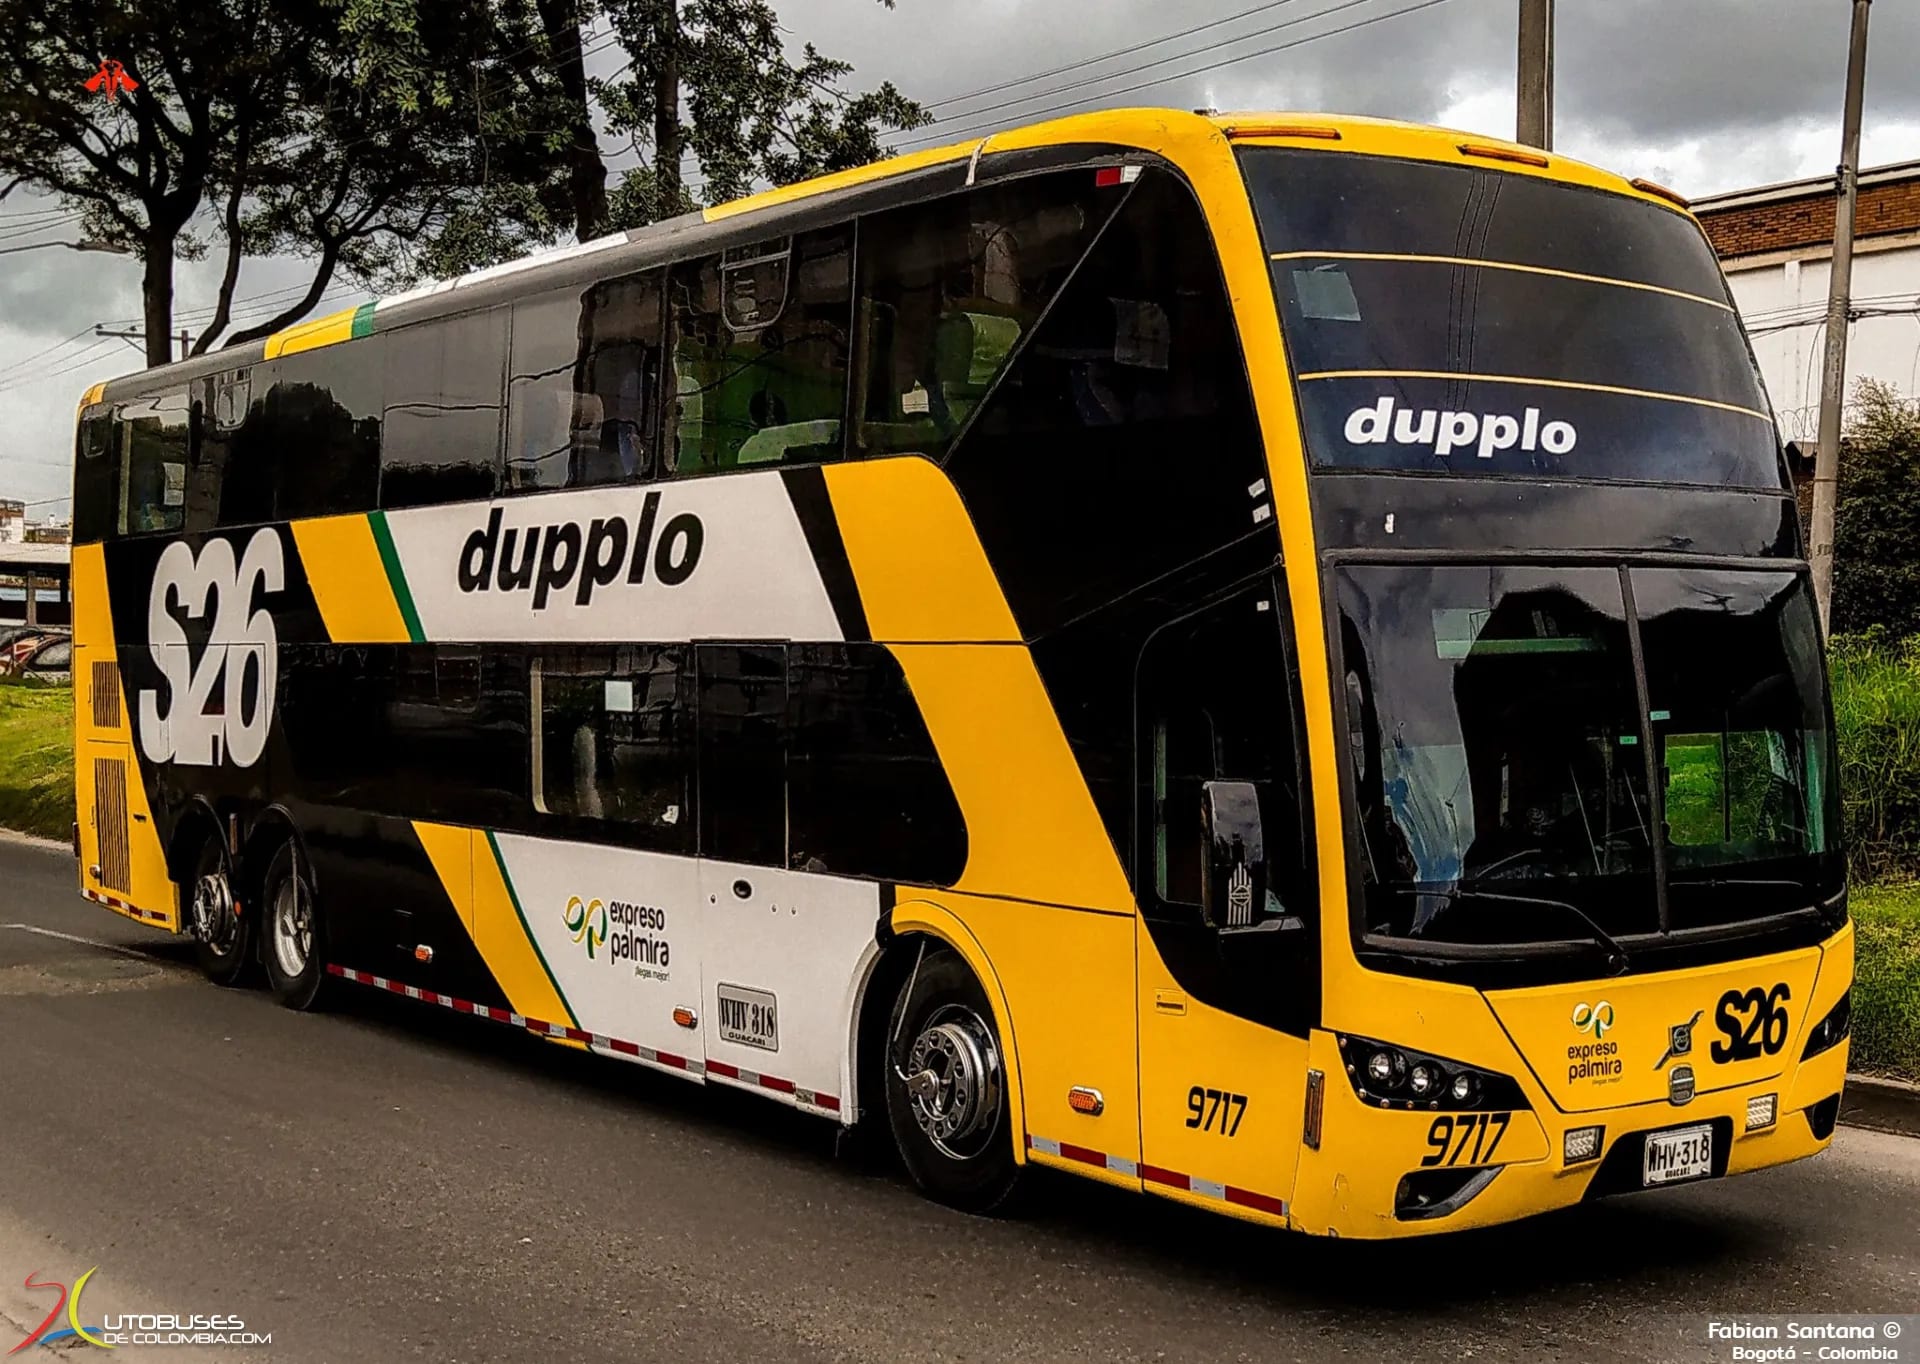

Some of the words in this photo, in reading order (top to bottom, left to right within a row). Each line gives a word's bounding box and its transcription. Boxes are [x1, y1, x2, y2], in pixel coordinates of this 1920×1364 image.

[1345, 397, 1577, 458] dupplo
[459, 492, 704, 610] dupplo
[138, 527, 285, 767] S26
[610, 900, 665, 932] expreso
[611, 929, 670, 967] palmira
[720, 998, 749, 1032] WHV
[752, 1003, 774, 1038] 318
[1711, 982, 1790, 1064] S26
[1568, 1042, 1618, 1062] expreso
[1569, 1057, 1622, 1085] palmira
[1185, 1086, 1249, 1137] 9717
[1420, 1112, 1511, 1168] 9717
